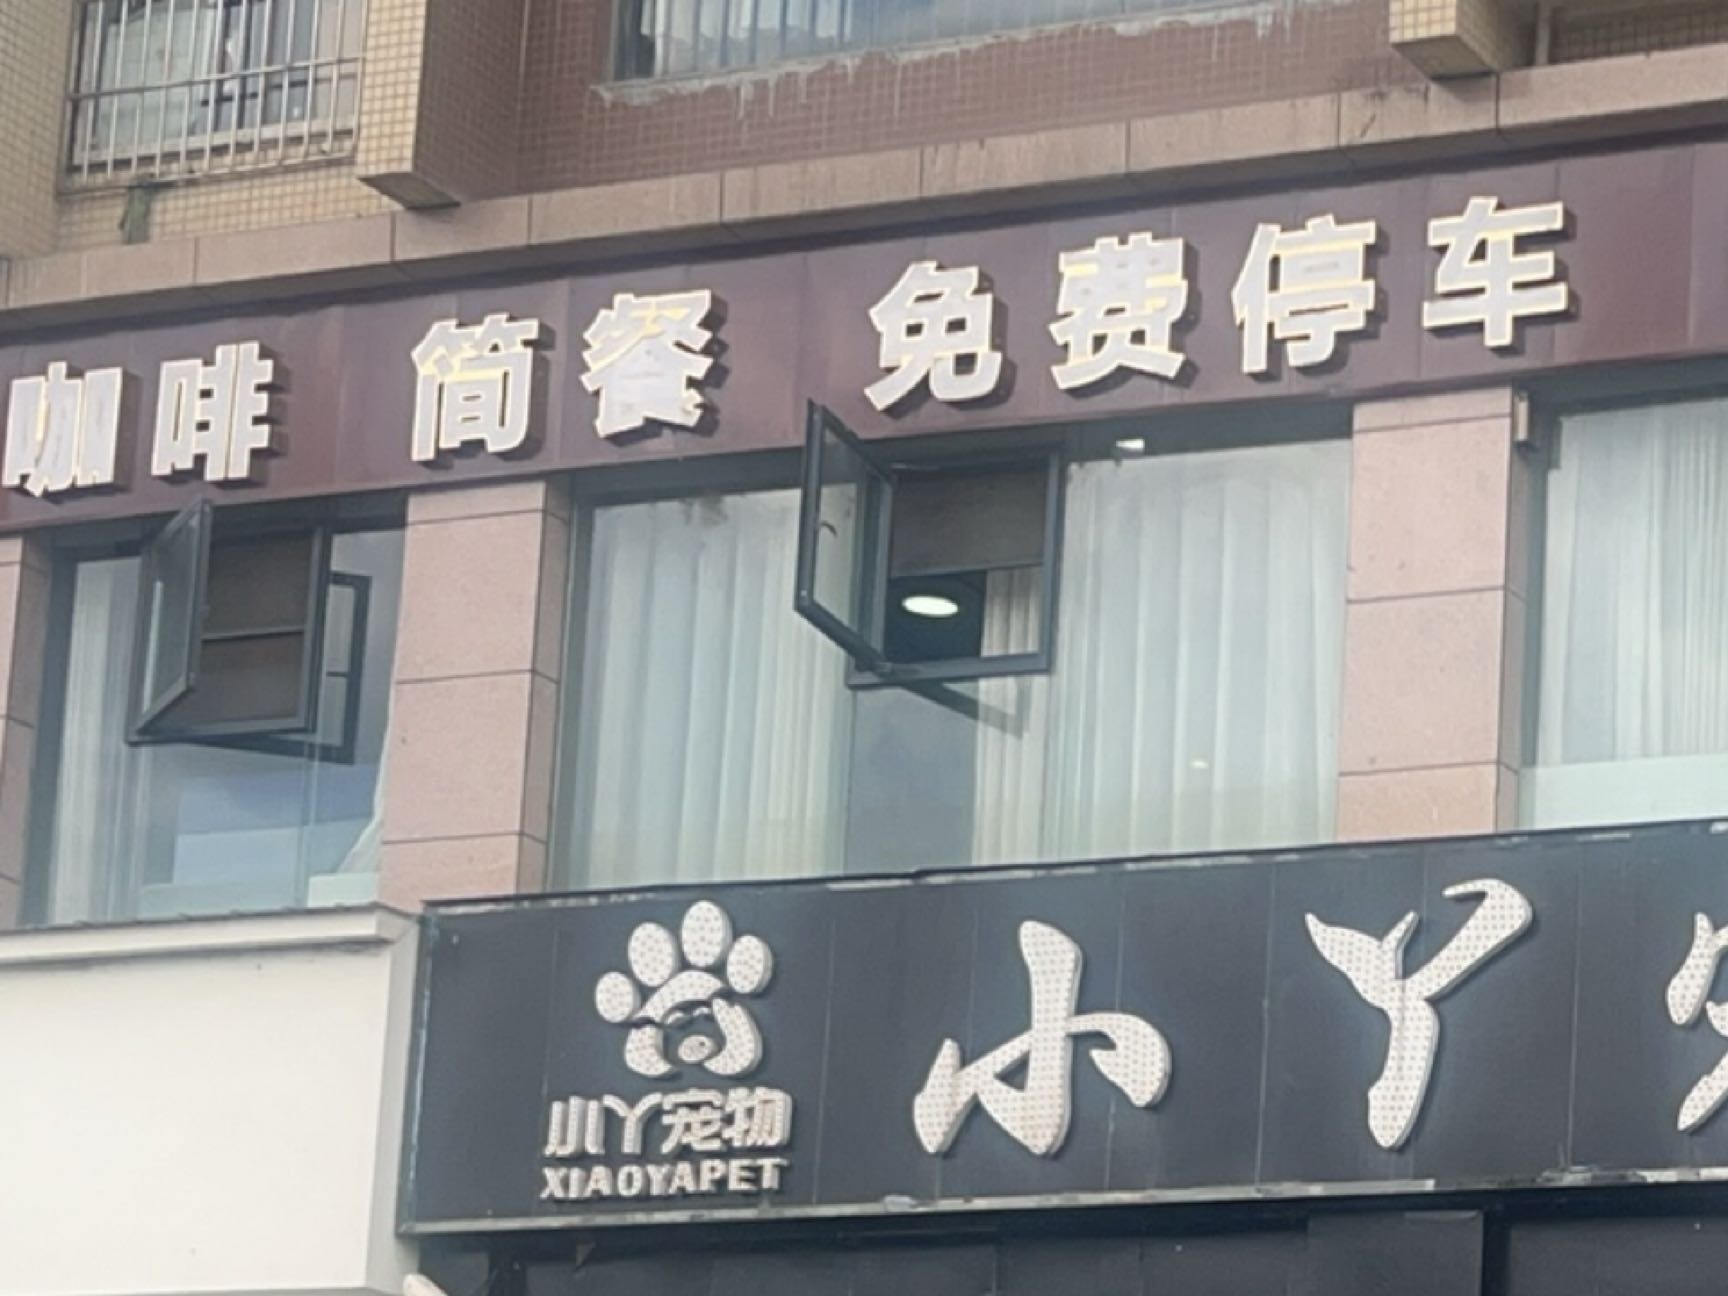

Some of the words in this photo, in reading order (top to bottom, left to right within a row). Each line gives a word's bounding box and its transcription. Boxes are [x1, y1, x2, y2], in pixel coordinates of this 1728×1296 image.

[2, 341, 274, 498] 咖啡
[410, 289, 714, 462] 简餐
[863, 195, 1568, 411] 免费停车
[544, 1087, 793, 1157] 小丫宠物
[540, 1157, 790, 1198] XIAOYAPET
